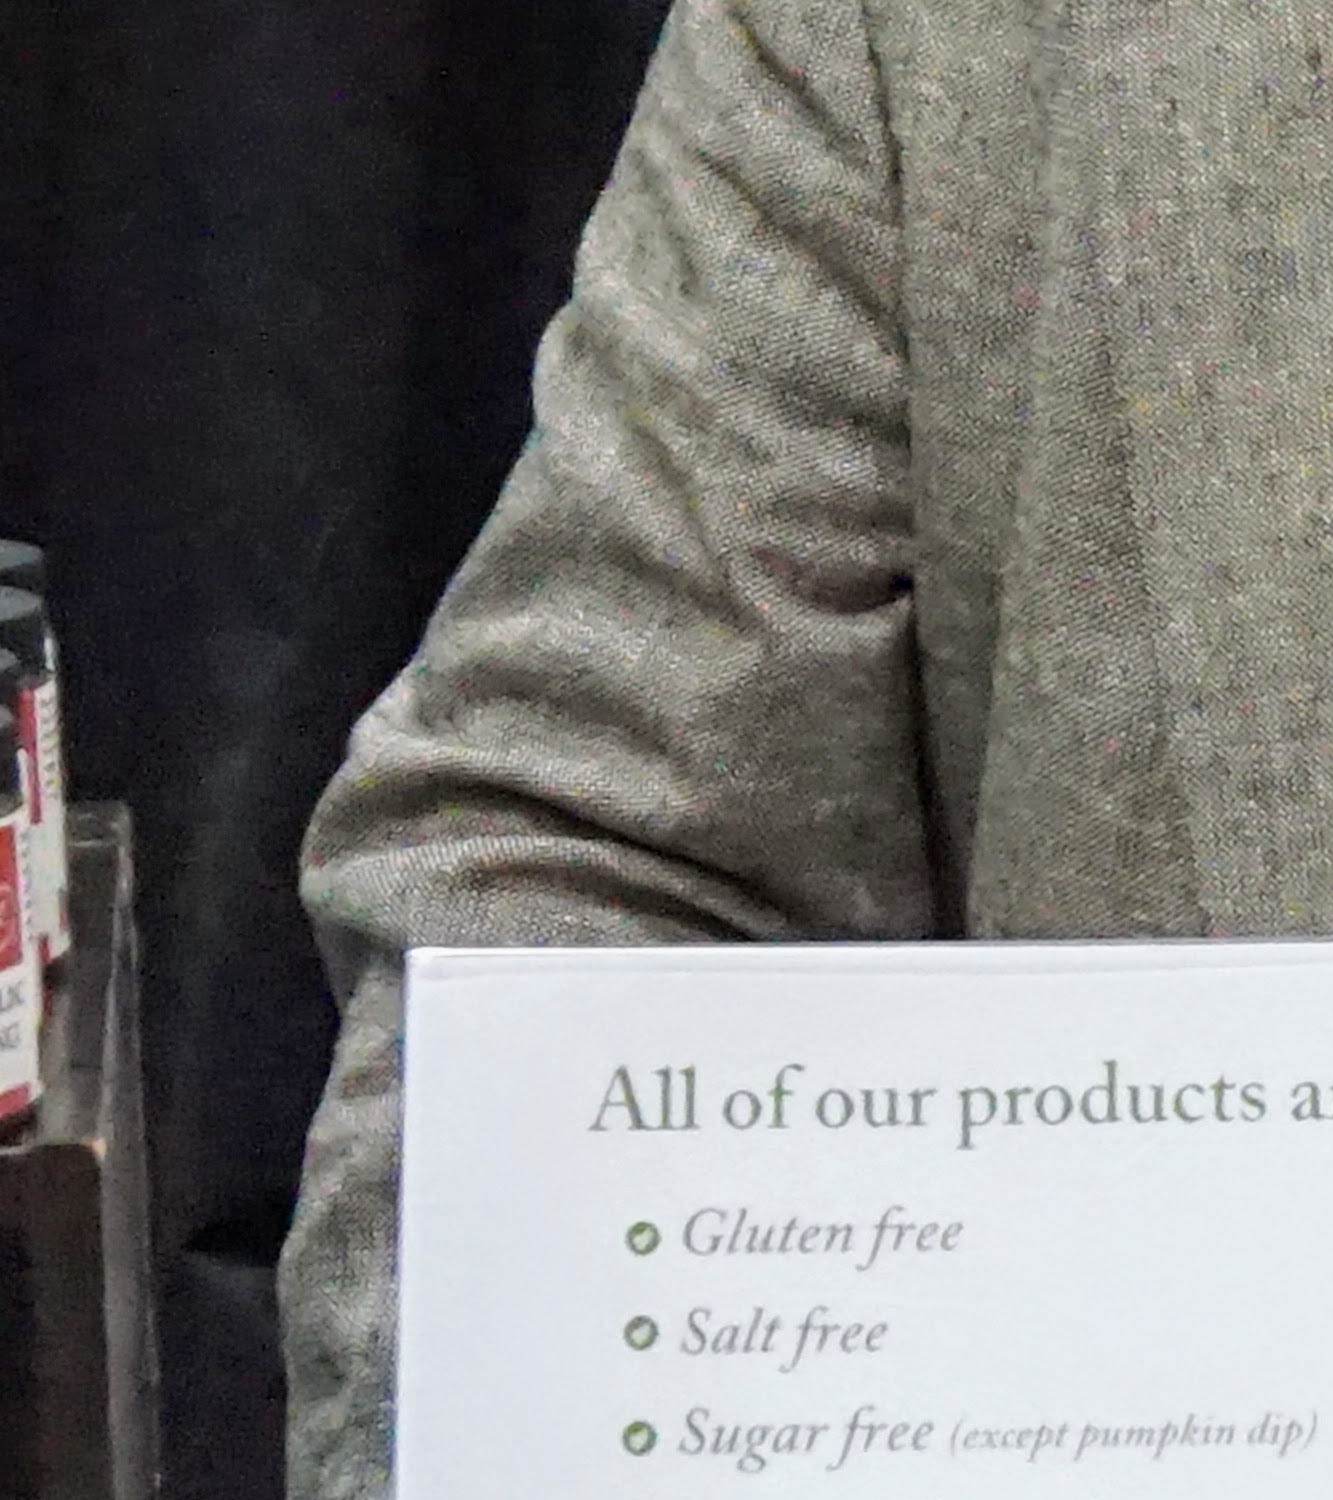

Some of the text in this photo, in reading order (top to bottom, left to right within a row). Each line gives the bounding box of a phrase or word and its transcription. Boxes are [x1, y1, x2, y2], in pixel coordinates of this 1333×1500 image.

[588, 1064, 702, 1133] All
[722, 1062, 806, 1130] of
[815, 1083, 938, 1130] our
[955, 1060, 1267, 1151] products
[681, 1206, 965, 1272] Gluten free
[680, 1306, 889, 1375] Salt free
[677, 1405, 1319, 1474] Sugar free (except pumpkin dip)
